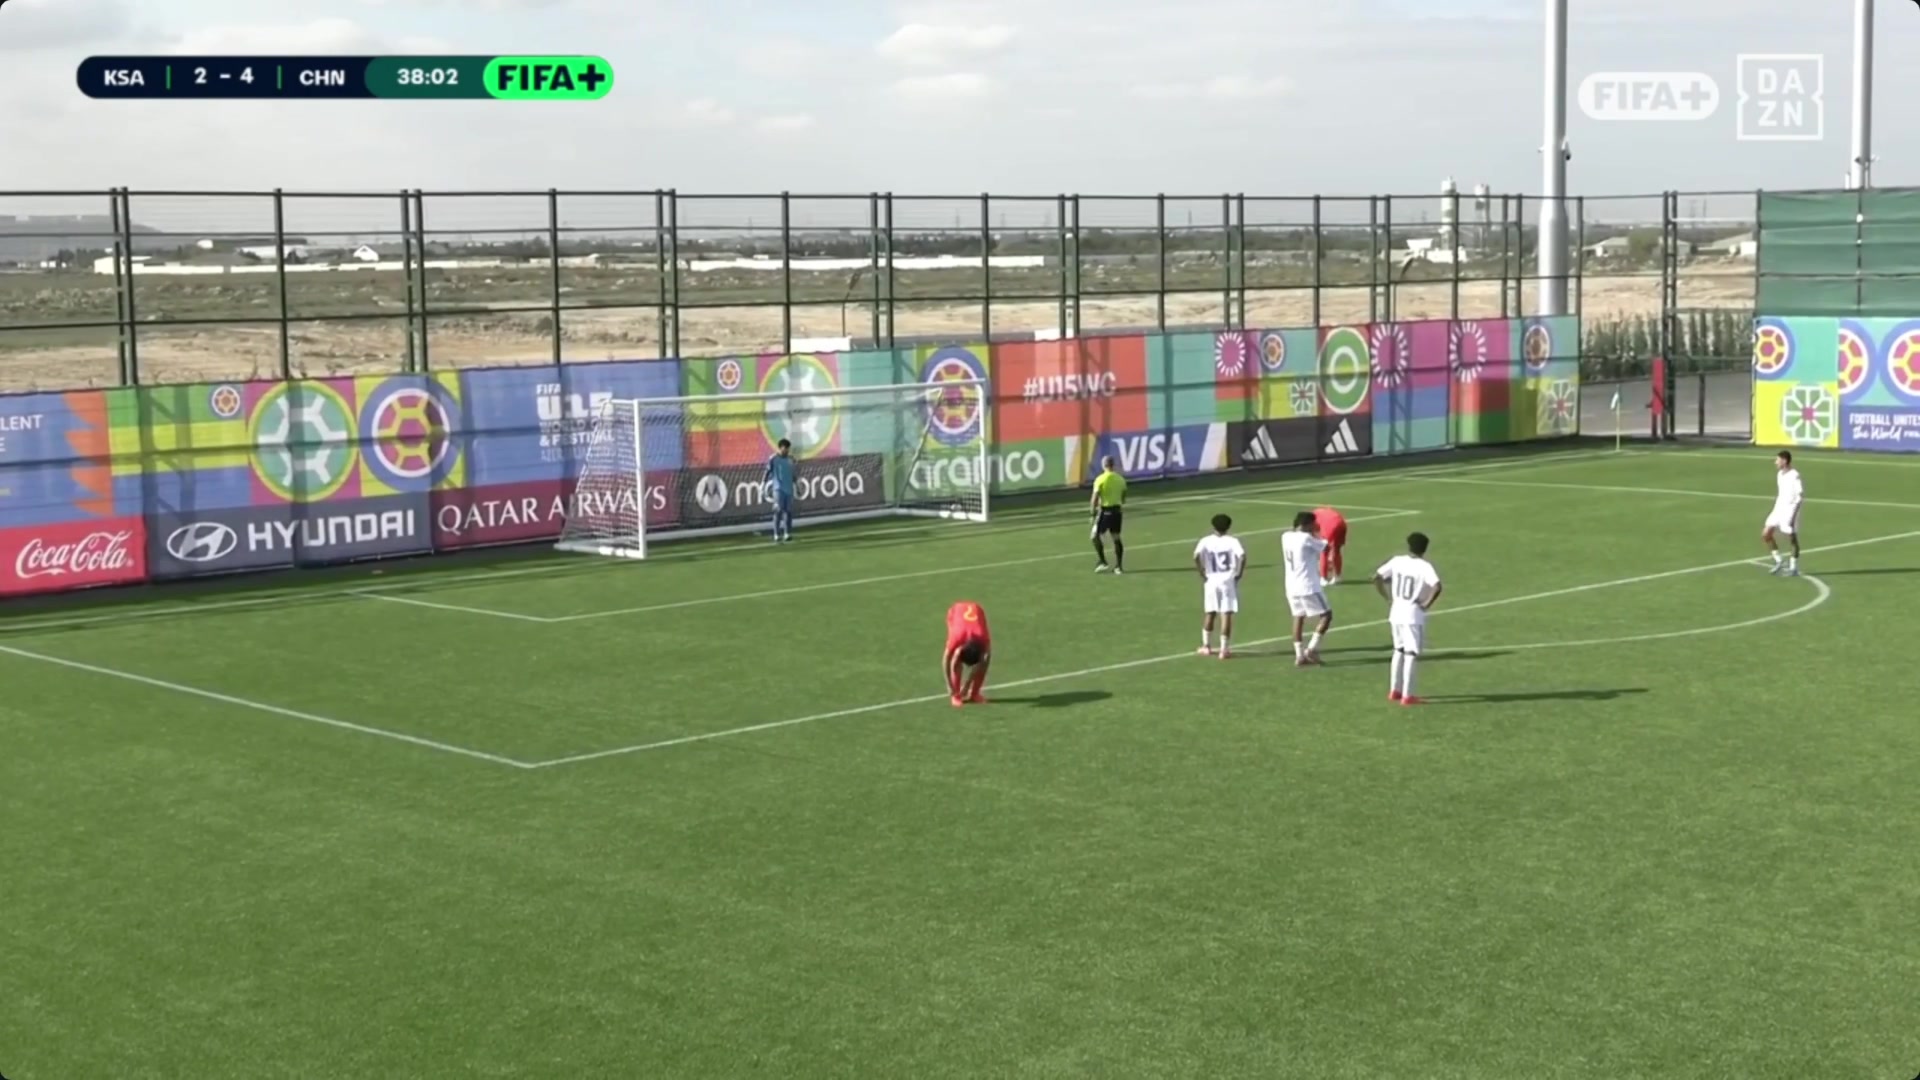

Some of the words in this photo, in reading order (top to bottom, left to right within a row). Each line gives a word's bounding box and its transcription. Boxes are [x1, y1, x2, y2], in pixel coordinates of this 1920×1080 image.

[1023, 371, 1116, 403] #U15WC
[537, 391, 614, 420] U15
[1849, 413, 1890, 426] FOOTBALL
[1111, 432, 1185, 472] VISA
[909, 450, 1044, 490] aramco
[735, 467, 864, 507] moorola
[248, 509, 415, 552] HYUNDAI
[438, 497, 539, 536] QATAR
[1210, 551, 1232, 573] 13
[1285, 550, 1295, 571] 4
[1397, 573, 1415, 600] 10
